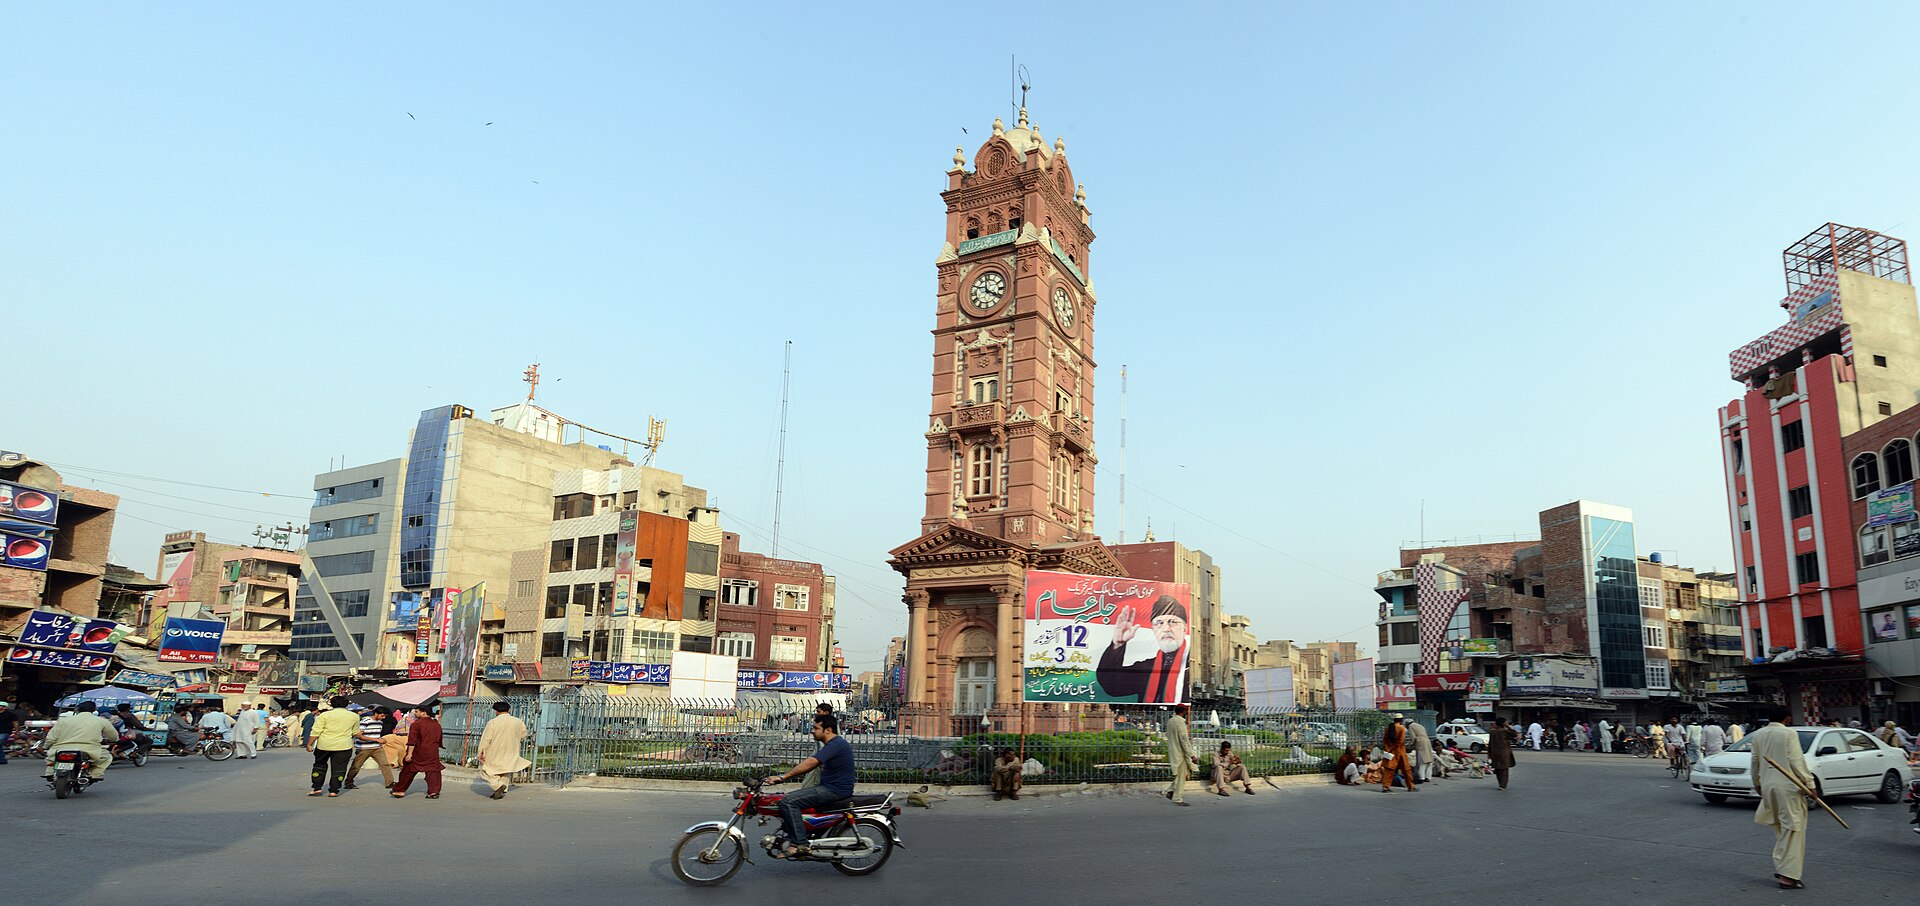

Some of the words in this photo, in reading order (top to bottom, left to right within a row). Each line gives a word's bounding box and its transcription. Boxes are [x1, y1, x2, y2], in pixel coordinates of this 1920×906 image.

[1068, 578, 1090, 595] تحریک
[1085, 579, 1098, 595] گیر
[1094, 582, 1109, 594] ملک
[1108, 581, 1118, 596] کی
[1115, 585, 1139, 598] انقلاب
[1138, 585, 1155, 598] عوامی
[1036, 589, 1098, 625] عام
[1074, 595, 1117, 625] جلسہ
[31, 616, 73, 628] برقاب
[184, 630, 220, 639] VOICE
[1033, 626, 1063, 645] اکتوبر
[1063, 625, 1087, 647] 12
[1055, 647, 1065, 662] 3
[614, 665, 630, 673] عرفان
[651, 665, 670, 674] عرفان
[737, 670, 755, 680] epsi
[1031, 678, 1058, 696] تحریک
[1054, 682, 1073, 696] عوامی
[1069, 681, 1096, 699] پاکستان
[1447, 682, 1469, 690] TCS
